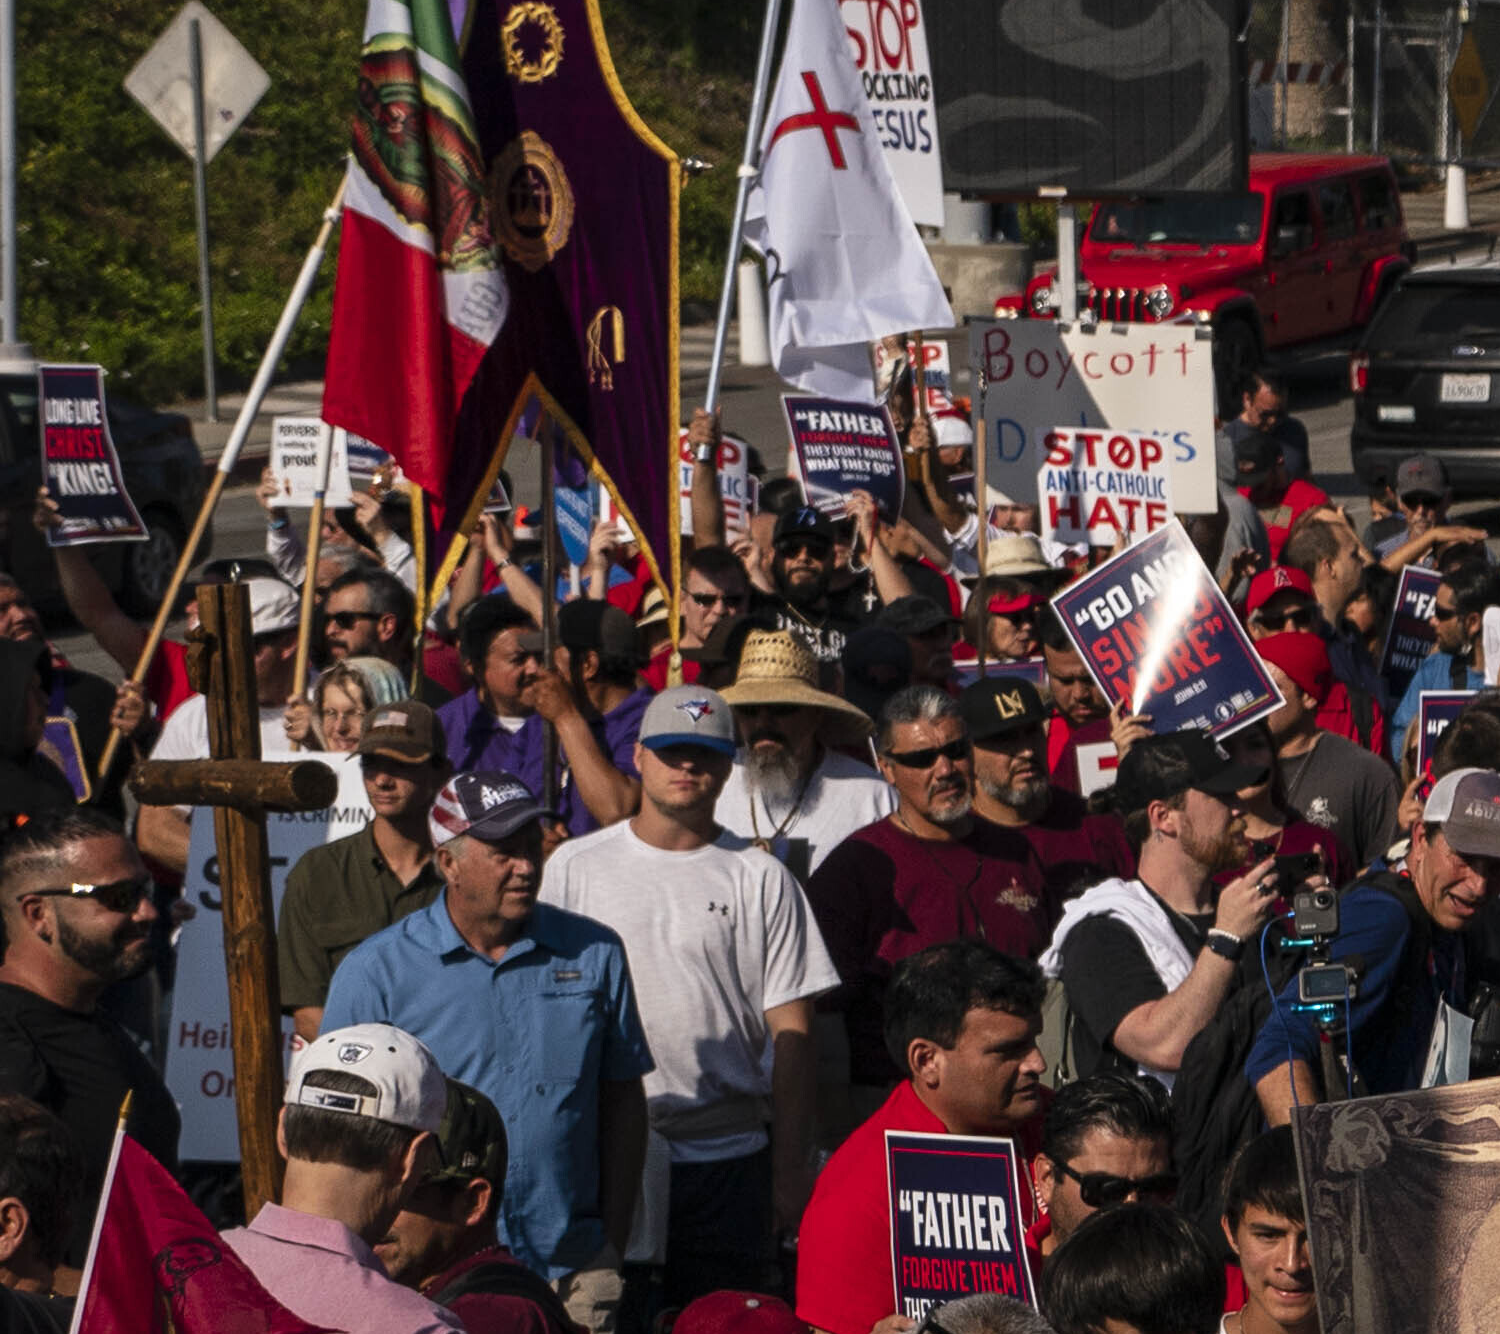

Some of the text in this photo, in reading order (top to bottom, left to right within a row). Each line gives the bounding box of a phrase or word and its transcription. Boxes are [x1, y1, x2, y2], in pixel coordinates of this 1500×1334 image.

[863, 71, 930, 101] OCKING
[872, 109, 932, 154] ESUS
[983, 328, 1195, 390] Boycott
[46, 427, 106, 459] CHRIST
[795, 410, 888, 436] “FATHER
[806, 458, 871, 472] WHAT THEY
[1043, 431, 1164, 472] STOP
[1045, 471, 1167, 499] ANTI-CATHOLIC
[1048, 495, 1168, 533] HATE
[1074, 584, 1134, 631] “GO
[1091, 610, 1152, 676] SIN
[899, 1189, 1012, 1252] “FATHER
[902, 1255, 1018, 1296] FORGIVE THEM
